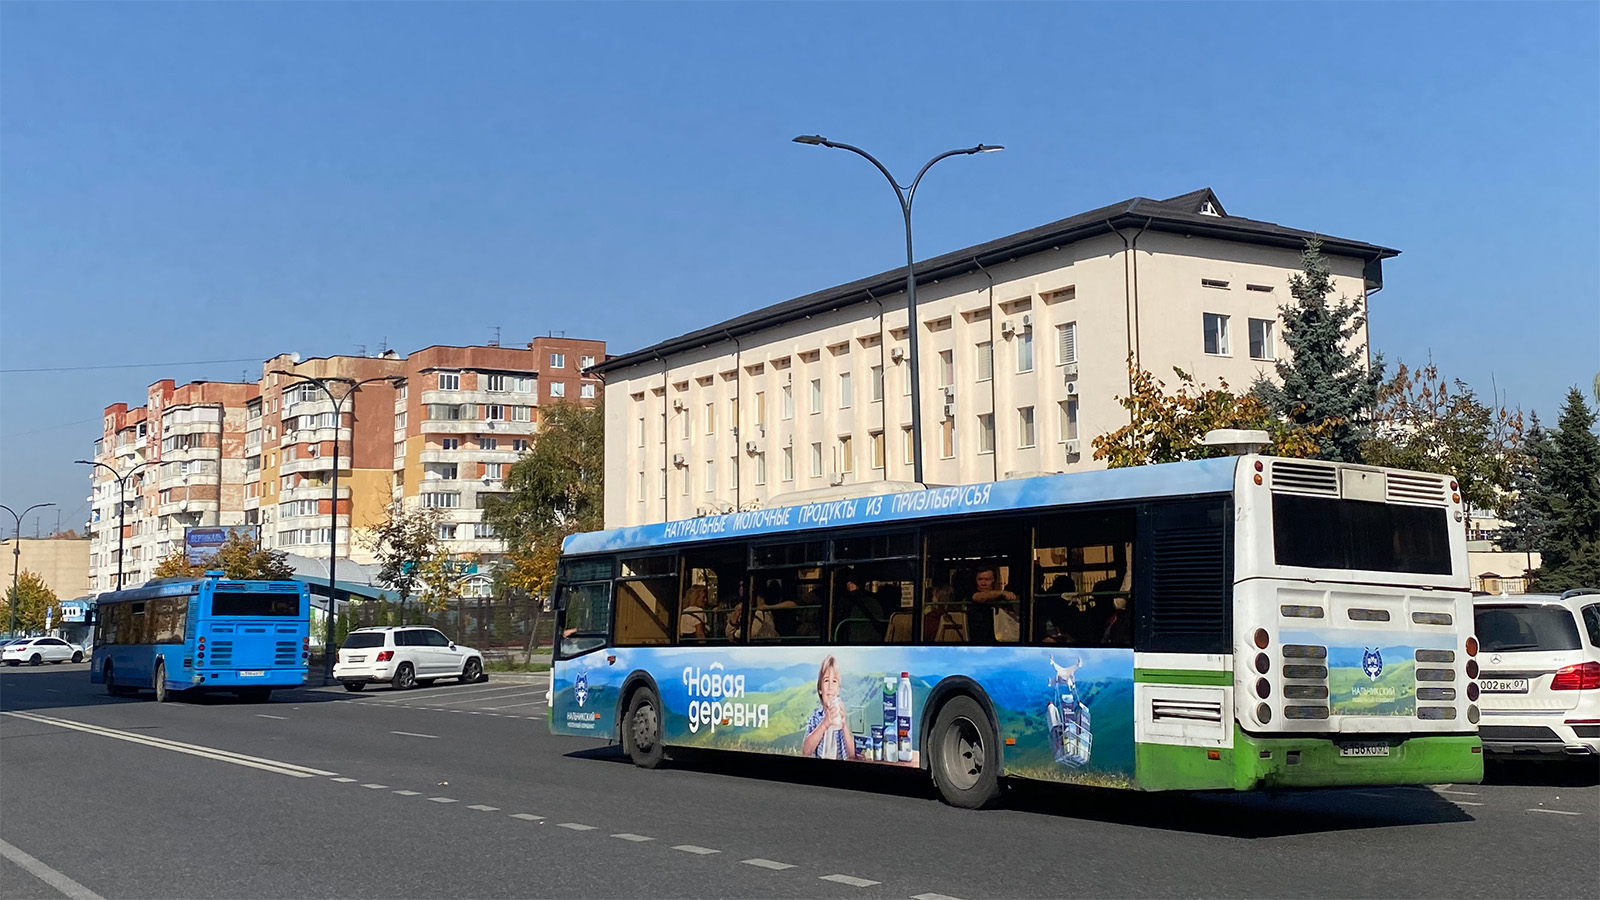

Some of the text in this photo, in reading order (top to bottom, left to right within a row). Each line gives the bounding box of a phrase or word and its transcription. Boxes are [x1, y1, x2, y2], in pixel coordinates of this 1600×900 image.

[664, 483, 993, 538] НАТУРАЛЬНЫЕ МОЛОЧНЫЕ ПРОДУКТЫ ИЗ ПРИЭЛЬБРУСЬЯ
[682, 661, 745, 698] Новая
[1514, 680, 1525, 688] 07
[688, 700, 769, 734] деревня
